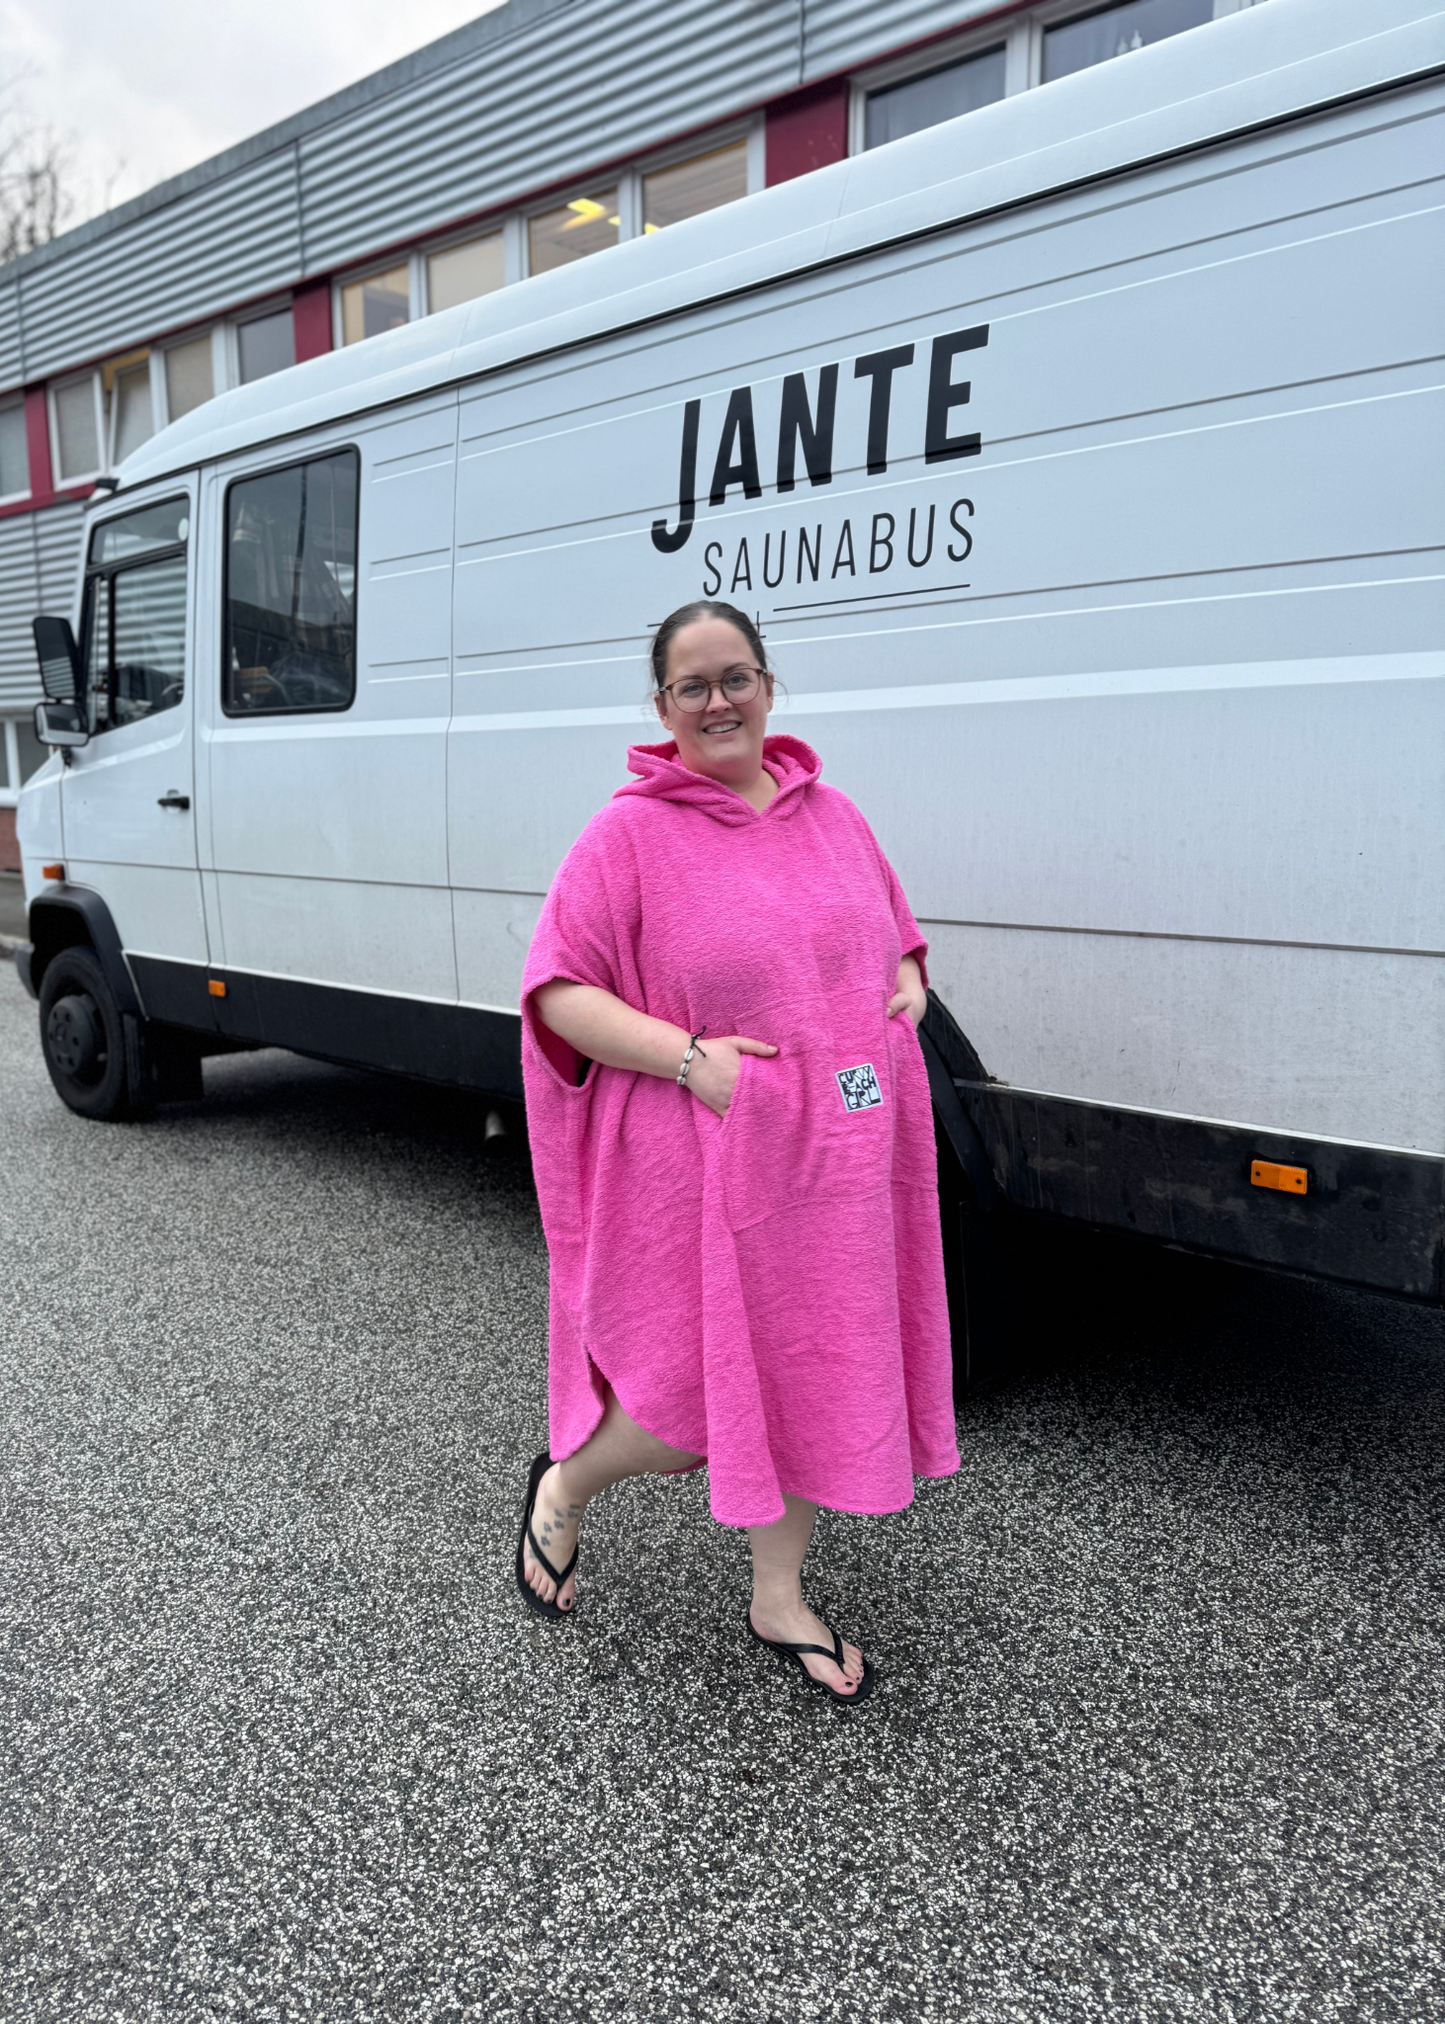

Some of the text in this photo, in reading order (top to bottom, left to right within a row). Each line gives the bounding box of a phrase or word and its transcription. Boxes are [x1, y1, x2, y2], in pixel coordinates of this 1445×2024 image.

[650, 323, 990, 554] JANTE
[702, 498, 975, 597] SAUNABUS
[837, 1065, 872, 1084] CURVY
[846, 1088, 881, 1110] GIRL
